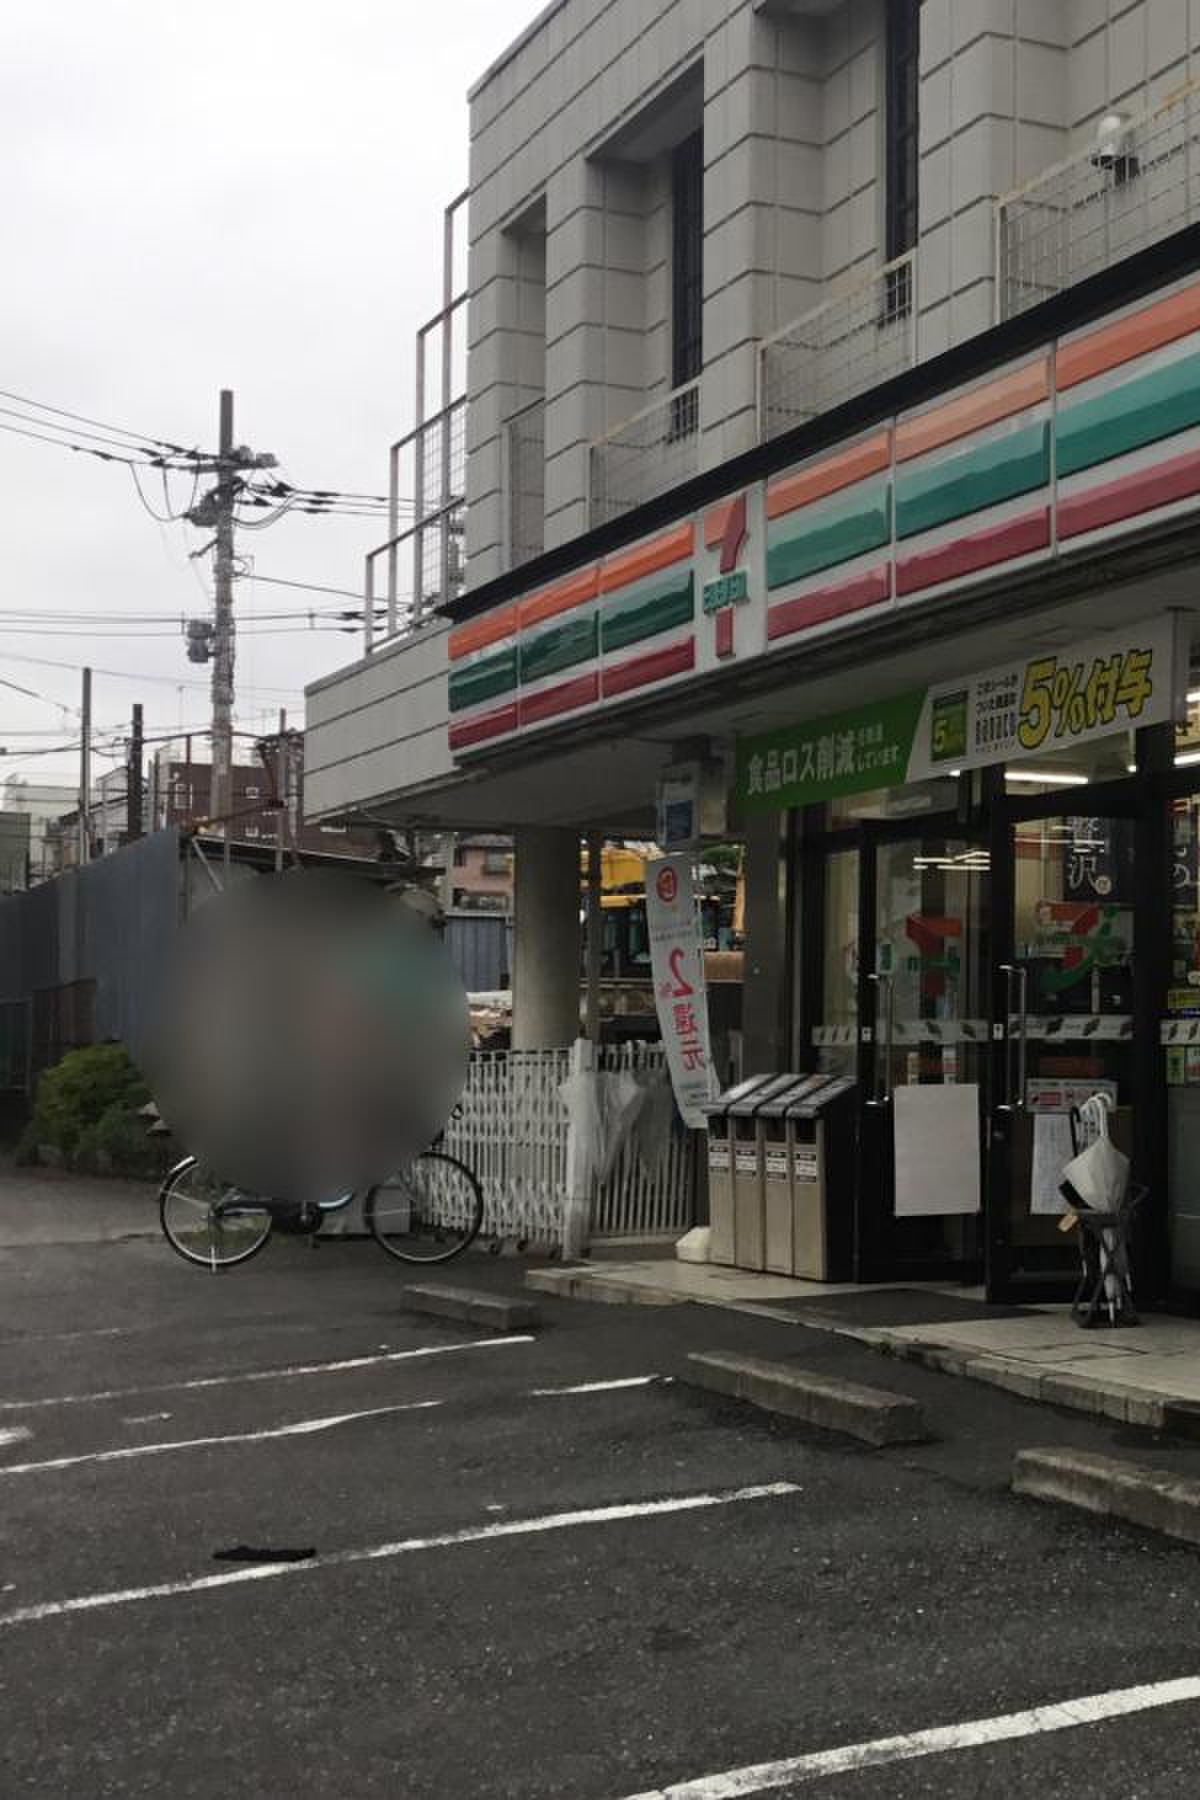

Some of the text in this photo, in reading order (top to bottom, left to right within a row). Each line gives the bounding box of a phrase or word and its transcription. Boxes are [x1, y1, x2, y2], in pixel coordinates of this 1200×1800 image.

[1018, 648, 1152, 749] 5%付与
[746, 731, 856, 796] 食品ロス削減
